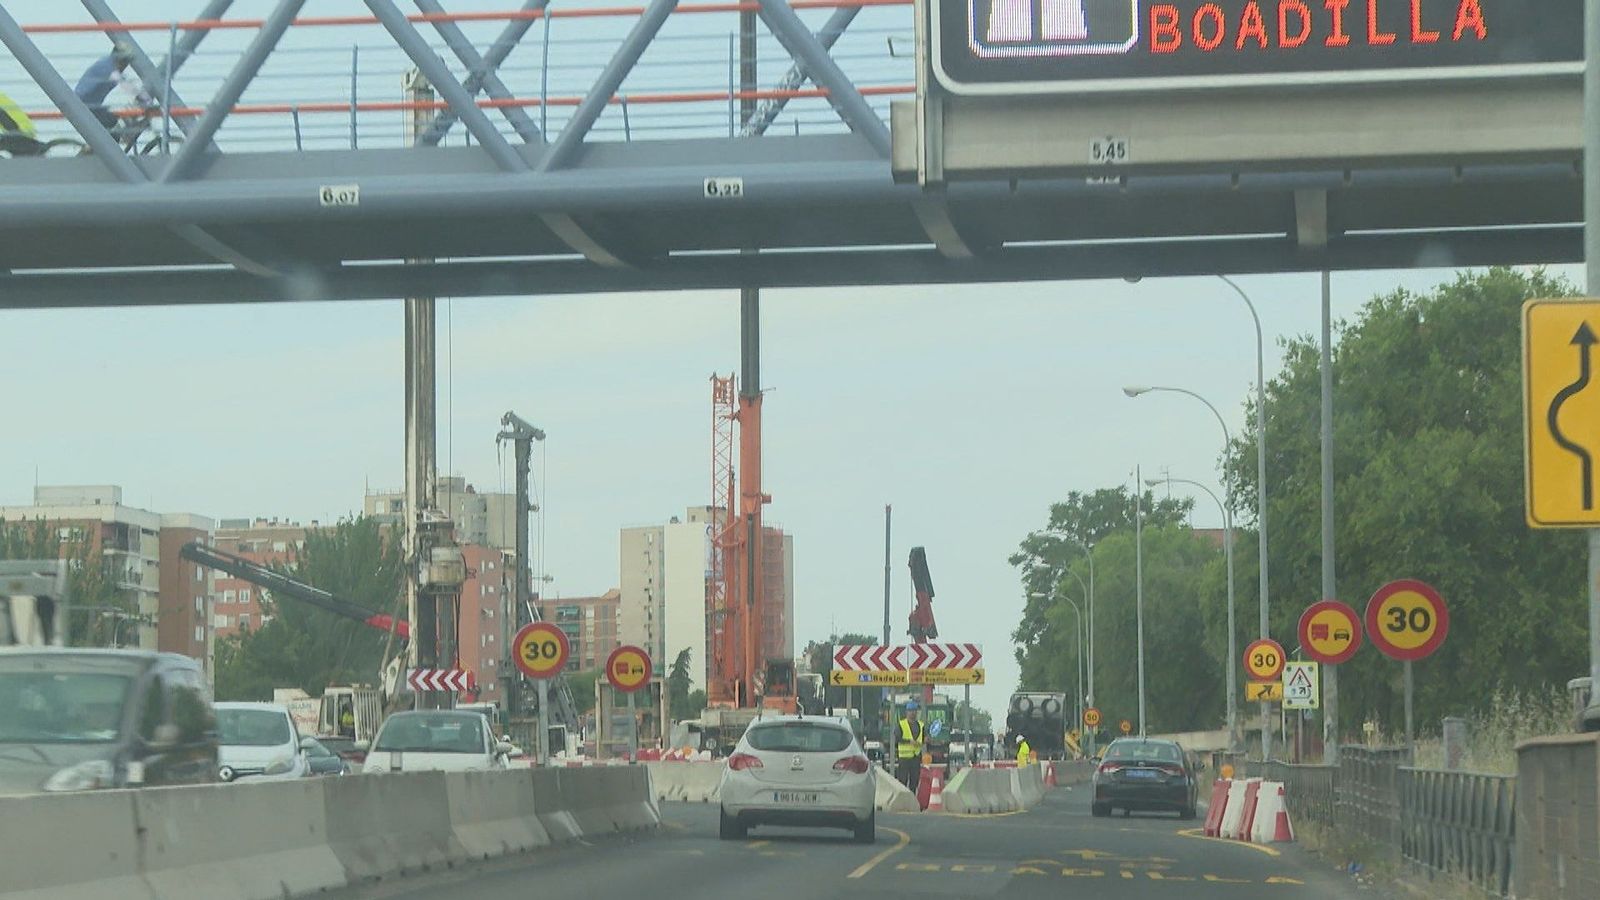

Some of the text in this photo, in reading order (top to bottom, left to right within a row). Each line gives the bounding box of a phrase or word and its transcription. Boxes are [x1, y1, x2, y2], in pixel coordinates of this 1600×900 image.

[1149, 0, 1487, 54] BOADILLA
[1386, 606, 1431, 634] 30
[524, 639, 558, 661] 30
[1254, 653, 1277, 668] 30
